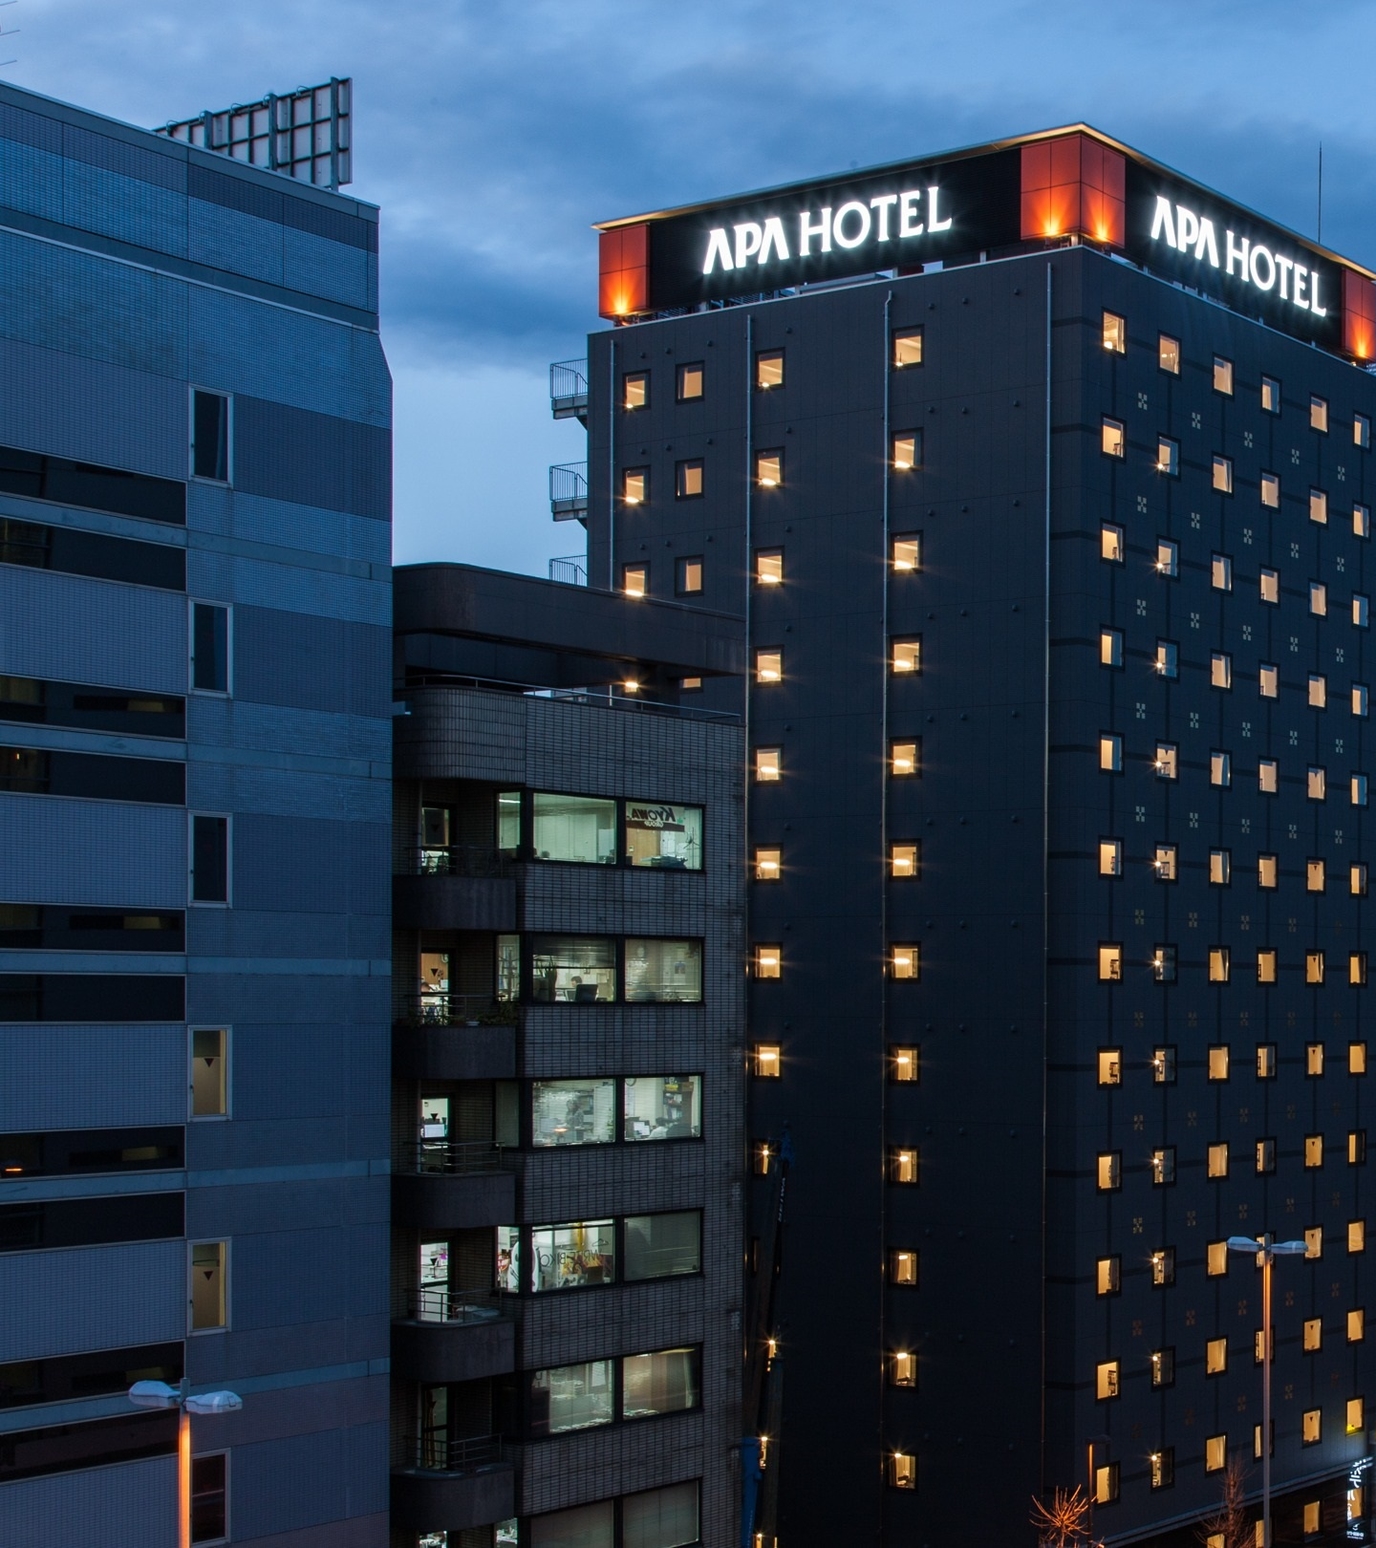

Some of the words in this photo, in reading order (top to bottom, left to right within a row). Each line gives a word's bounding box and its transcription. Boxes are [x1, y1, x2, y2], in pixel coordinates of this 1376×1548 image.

[702, 217, 790, 275] APA
[799, 186, 953, 257] HOTEL
[1150, 195, 1220, 268] APA
[1225, 229, 1328, 317] HOTEL
